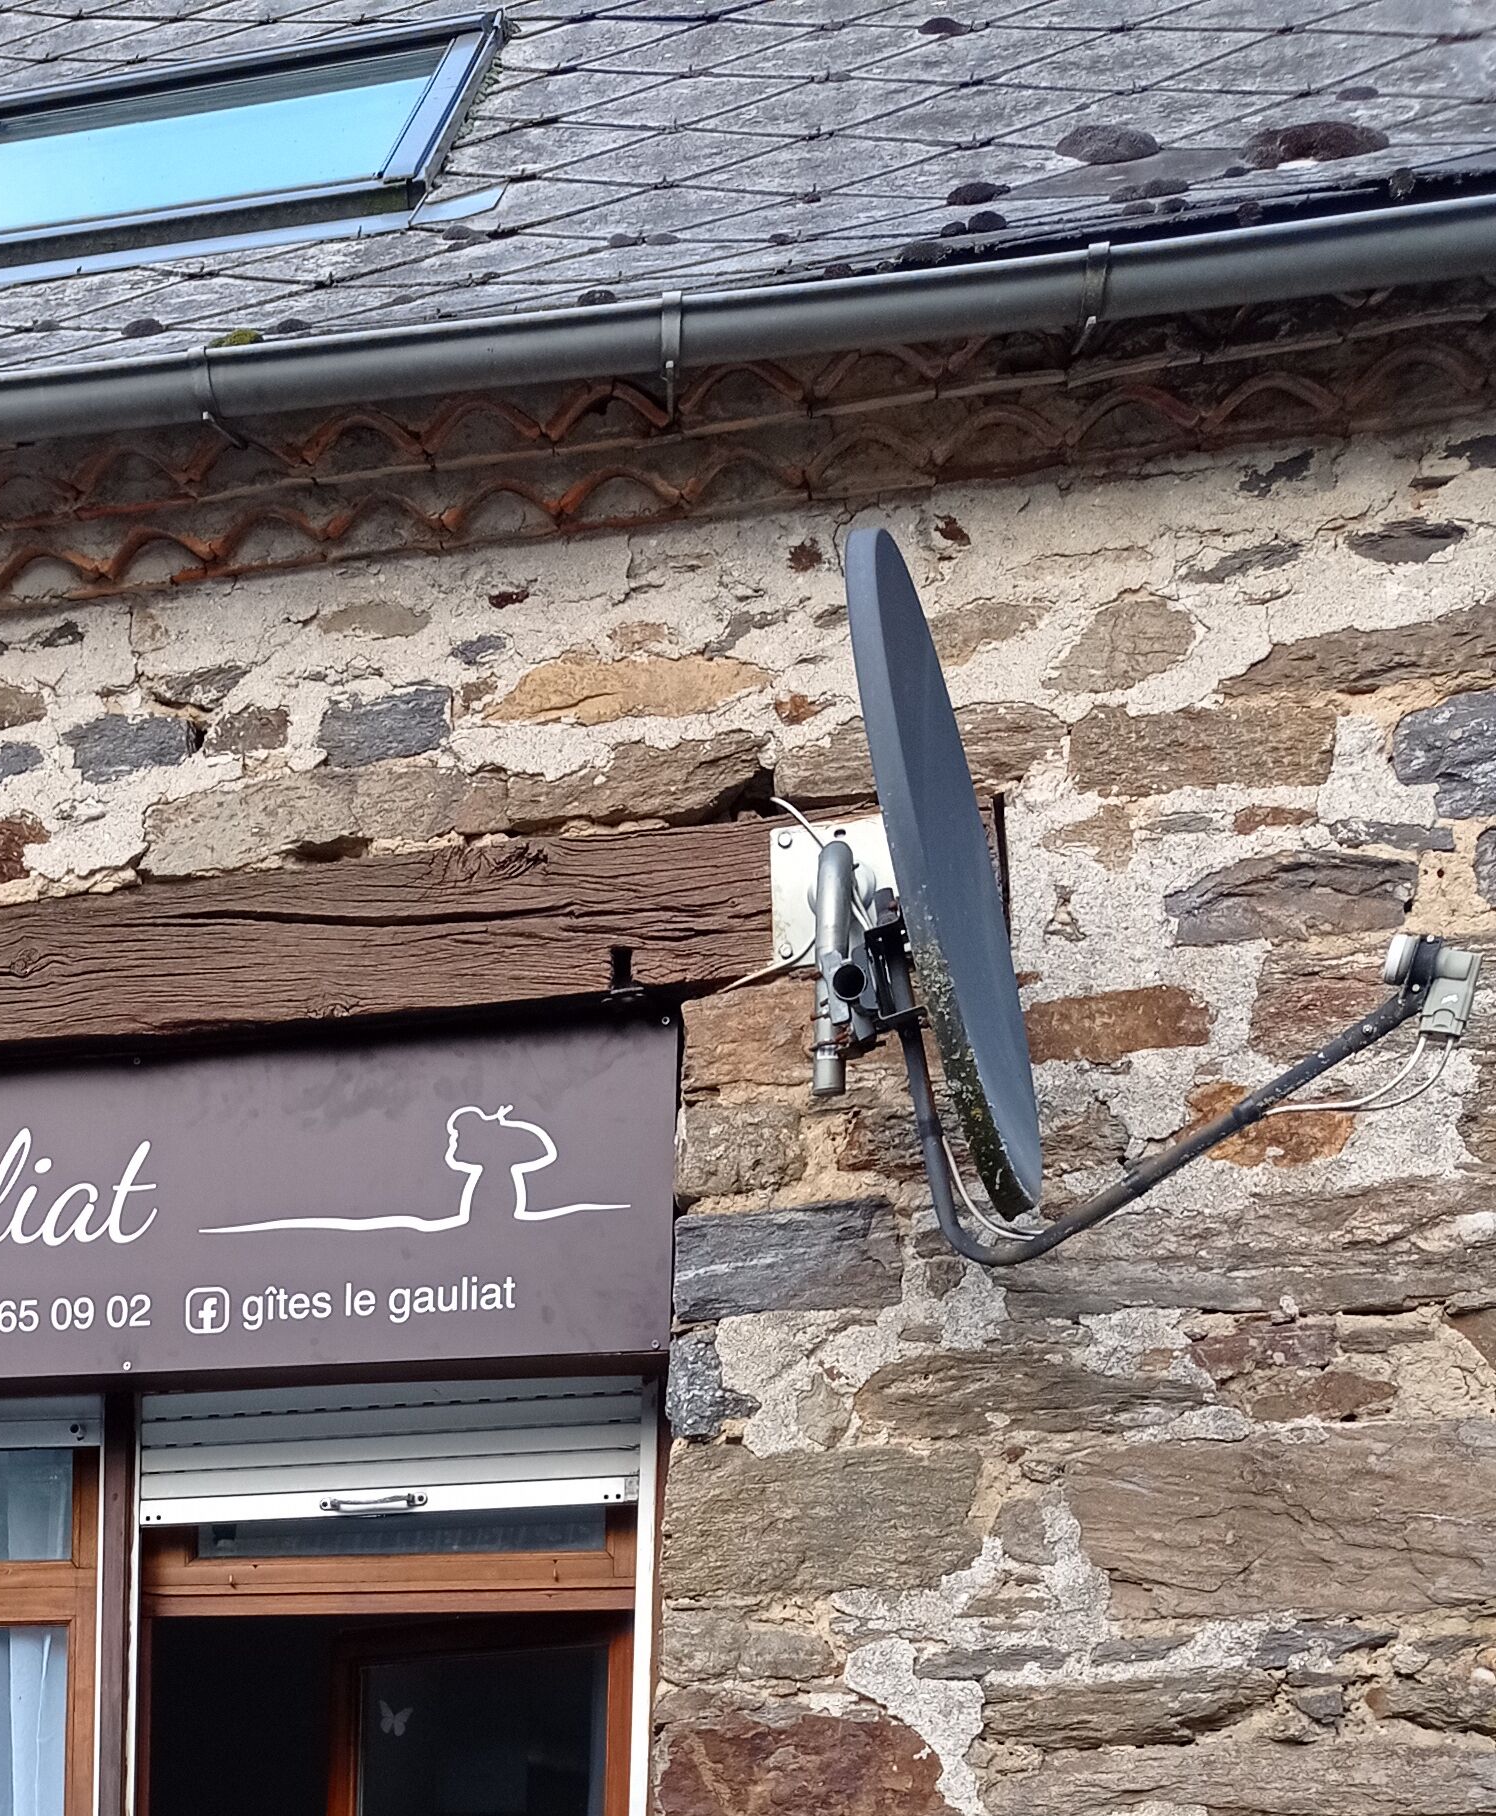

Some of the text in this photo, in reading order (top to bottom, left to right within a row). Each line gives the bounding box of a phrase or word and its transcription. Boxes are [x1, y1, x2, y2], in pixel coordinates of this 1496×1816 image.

[50, 1296, 95, 1331] 09
[106, 1294, 151, 1328] 02
[242, 1286, 332, 1331] gîtes
[345, 1282, 376, 1317] le
[388, 1276, 516, 1324] gauliat
